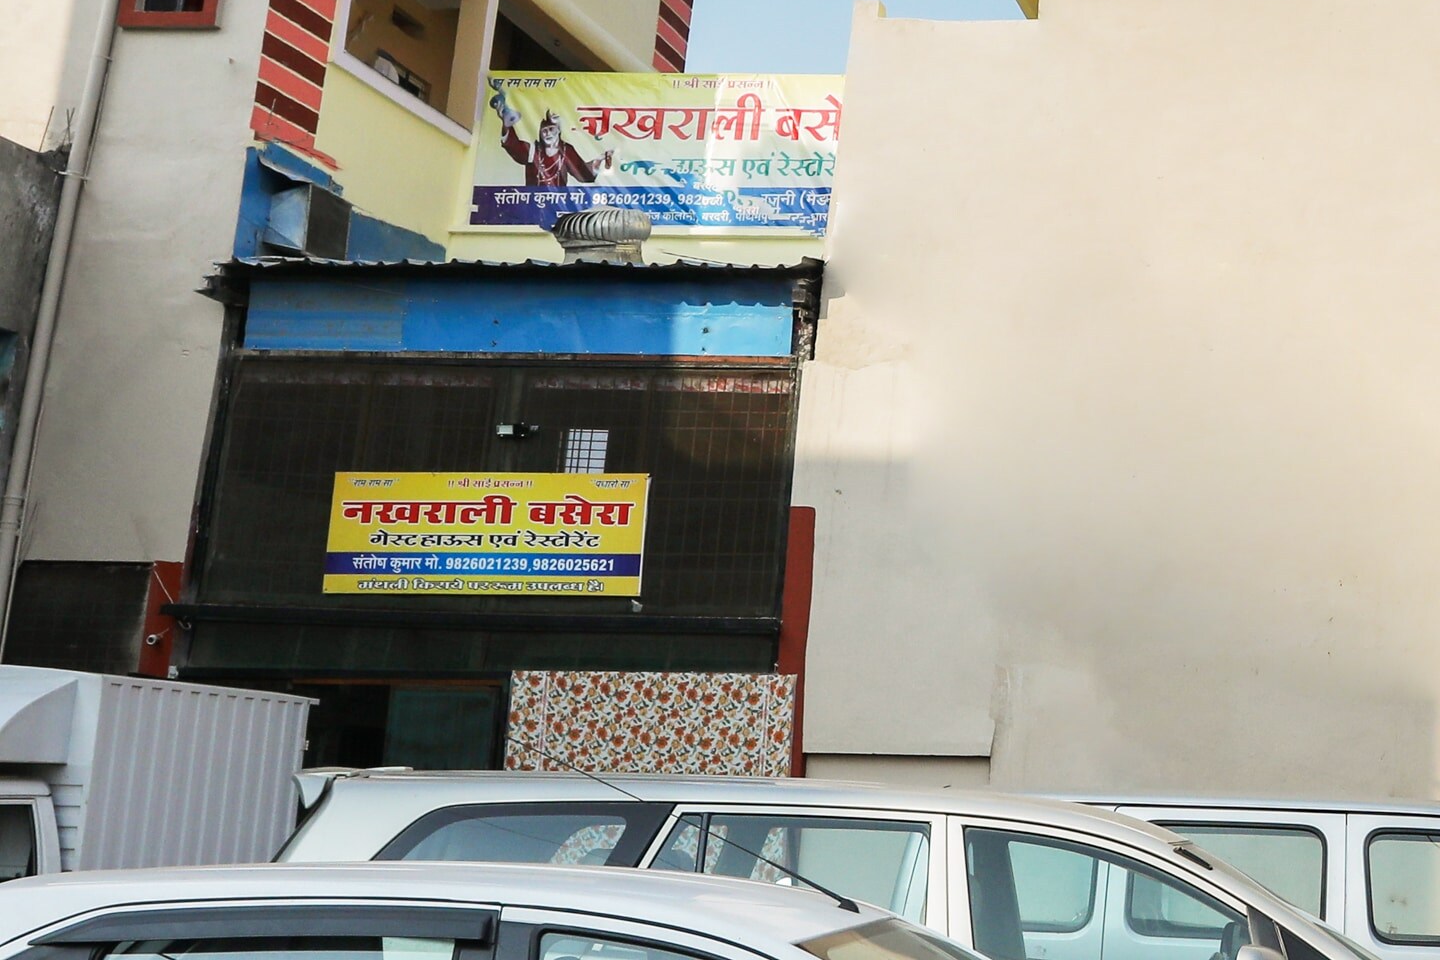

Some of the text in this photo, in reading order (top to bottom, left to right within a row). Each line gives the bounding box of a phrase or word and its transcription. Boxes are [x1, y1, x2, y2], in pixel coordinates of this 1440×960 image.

[742, 152, 775, 180] एवं
[493, 189, 532, 206] संतोष
[534, 192, 567, 208] कुमार
[592, 193, 674, 208] 9826021239,
[342, 494, 635, 525] नखराली बसेरा
[489, 530, 522, 548] एवं
[524, 530, 601, 547] रेस्टोरेंट
[352, 553, 388, 570] संतोष
[390, 556, 422, 573] कुमार
[358, 578, 409, 590] मंथली
[526, 581, 584, 592] उपलब्ध
